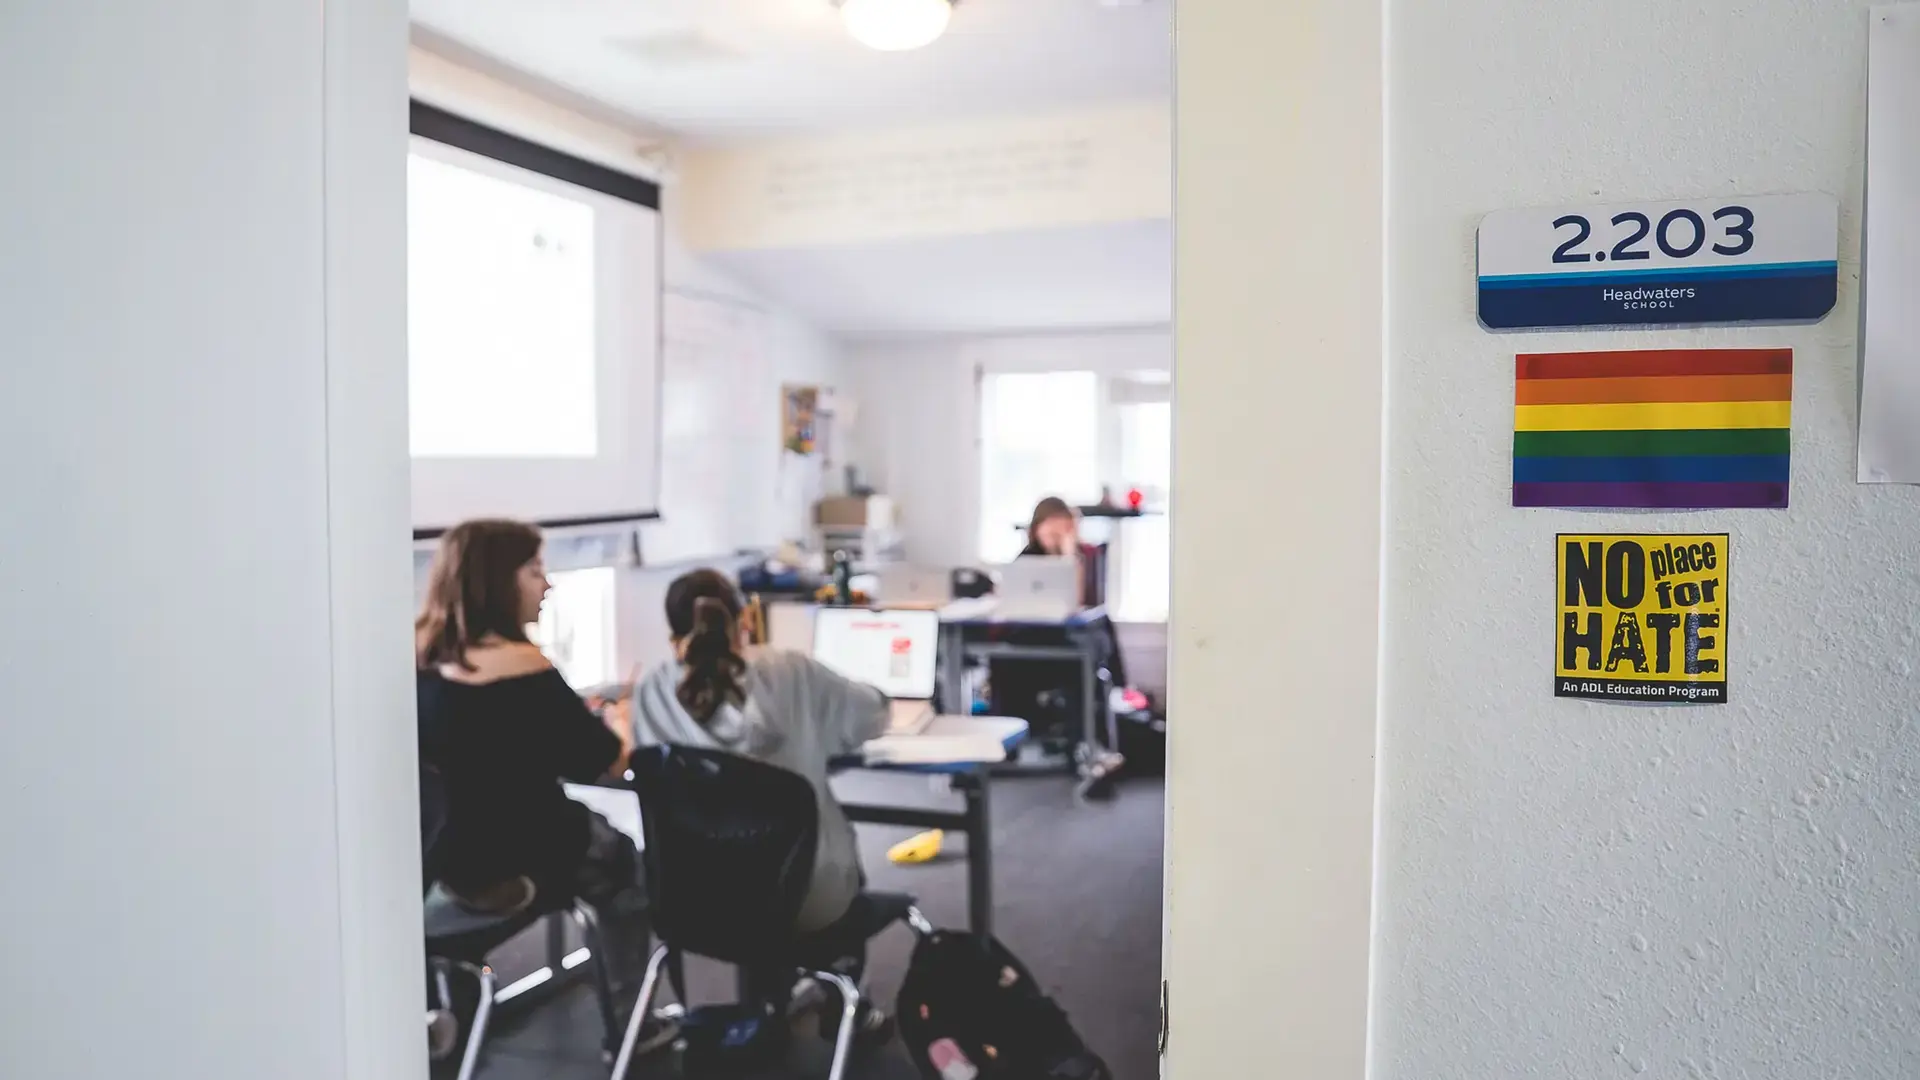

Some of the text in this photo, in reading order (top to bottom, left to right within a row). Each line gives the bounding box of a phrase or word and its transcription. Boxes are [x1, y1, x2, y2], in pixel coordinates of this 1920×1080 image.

[1552, 205, 1755, 263] 2.203
[1603, 286, 1695, 301] Headwaters
[1624, 300, 1675, 309] SCHOOL
[1565, 541, 1645, 609] NO
[1650, 542, 1717, 580] place
[1655, 578, 1719, 609] for
[1563, 612, 1720, 674] HATE
[1563, 681, 1719, 699] An ADL Education Program
